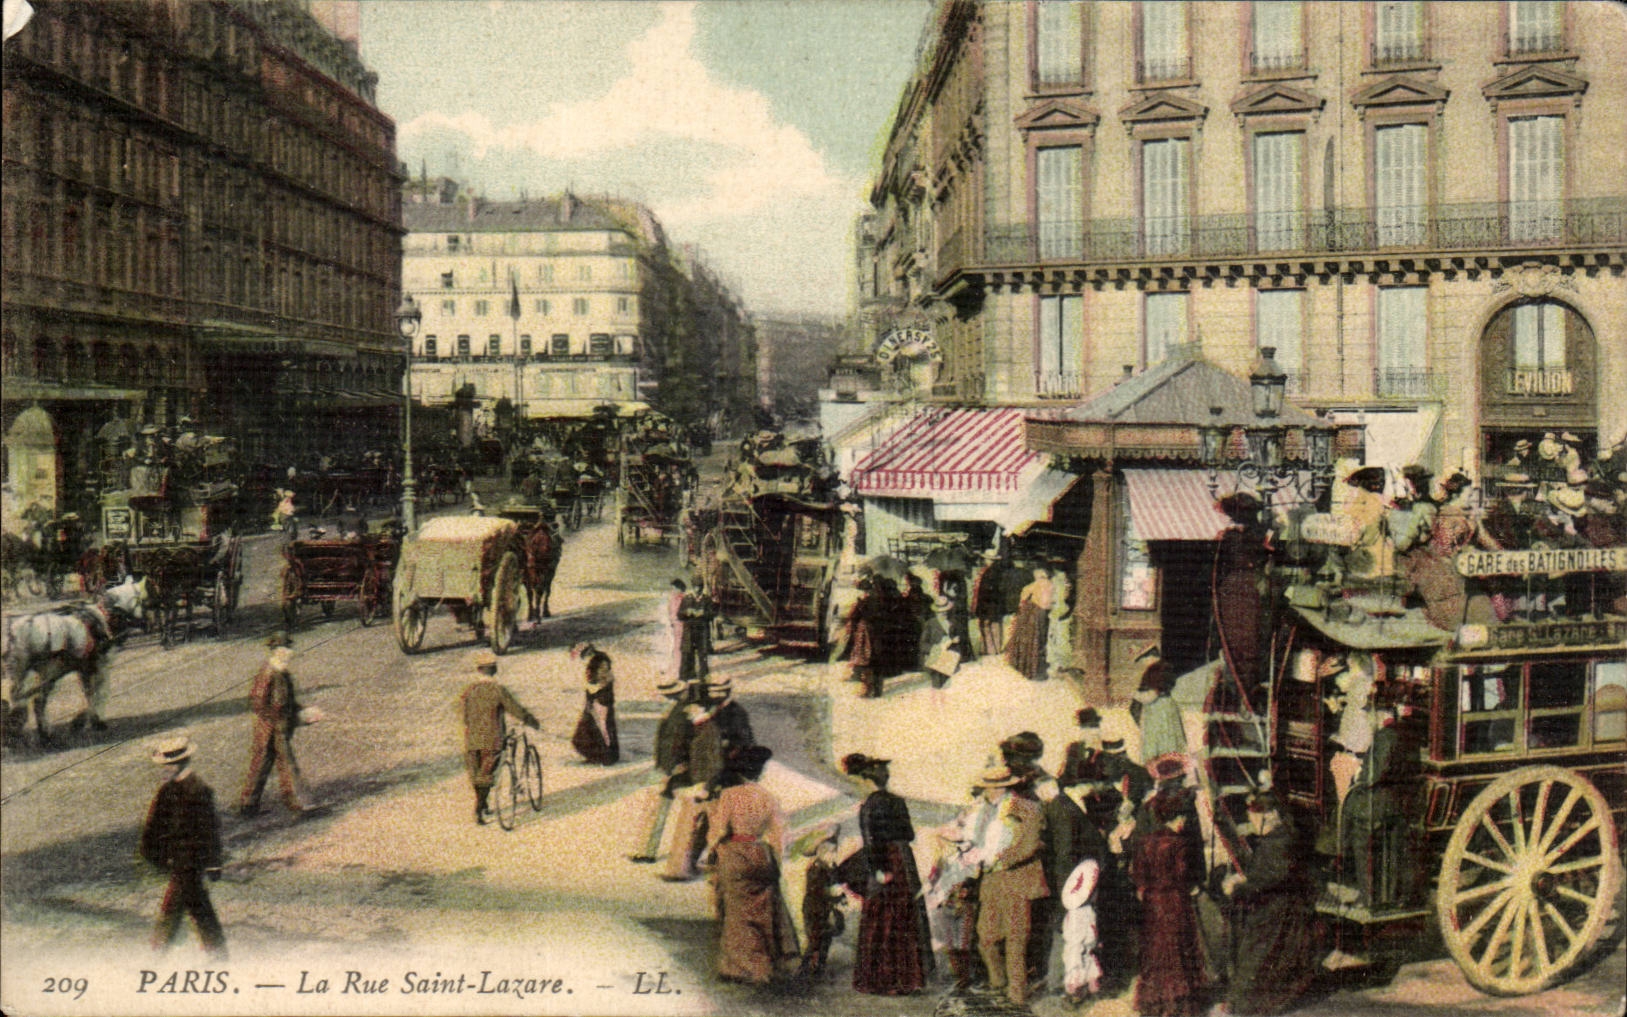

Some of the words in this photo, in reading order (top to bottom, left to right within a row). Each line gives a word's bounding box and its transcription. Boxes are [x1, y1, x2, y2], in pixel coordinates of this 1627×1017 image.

[1467, 554, 1503, 575] GARE
[1507, 558, 1525, 573] des
[1529, 550, 1617, 572] BATIGNOLLES
